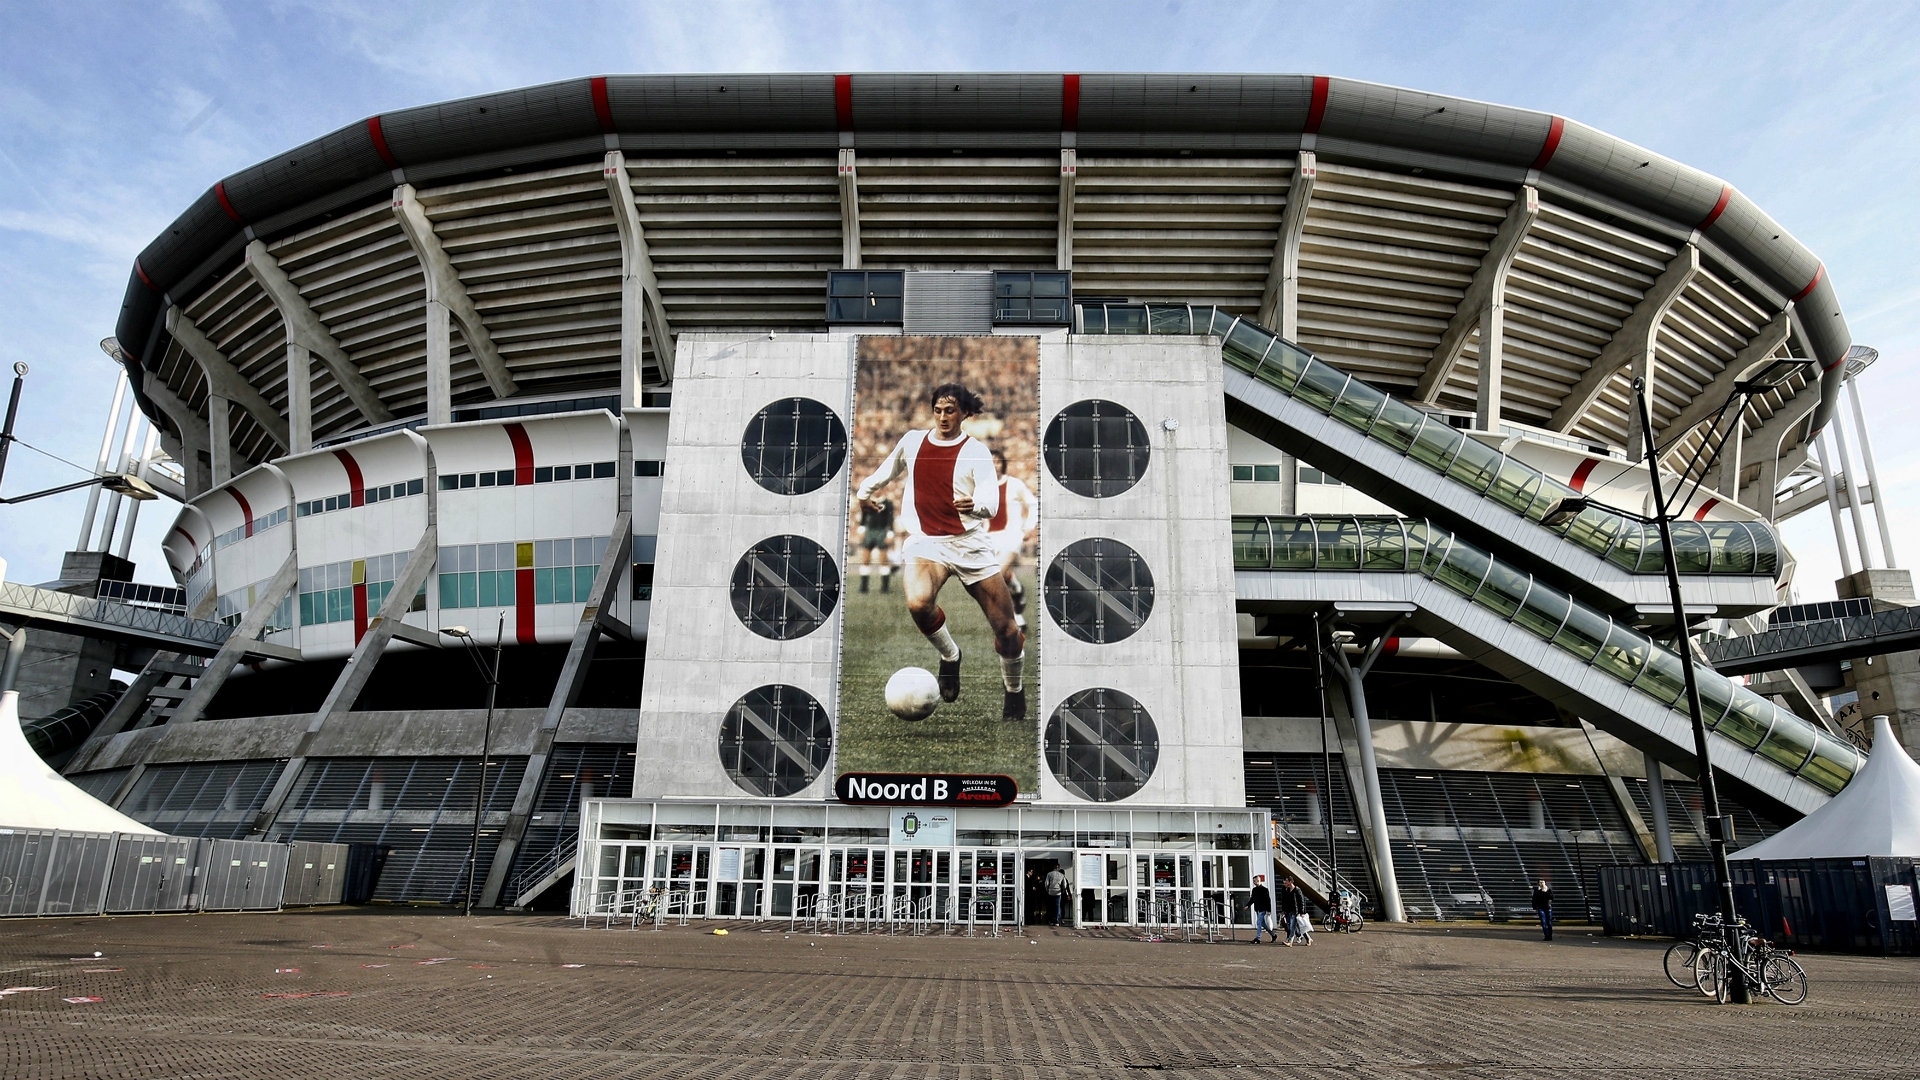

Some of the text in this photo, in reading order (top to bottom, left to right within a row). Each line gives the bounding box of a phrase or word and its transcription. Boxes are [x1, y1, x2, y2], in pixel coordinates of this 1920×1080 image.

[848, 777, 949, 800] Noord B
[956, 792, 1002, 801] ArenA
